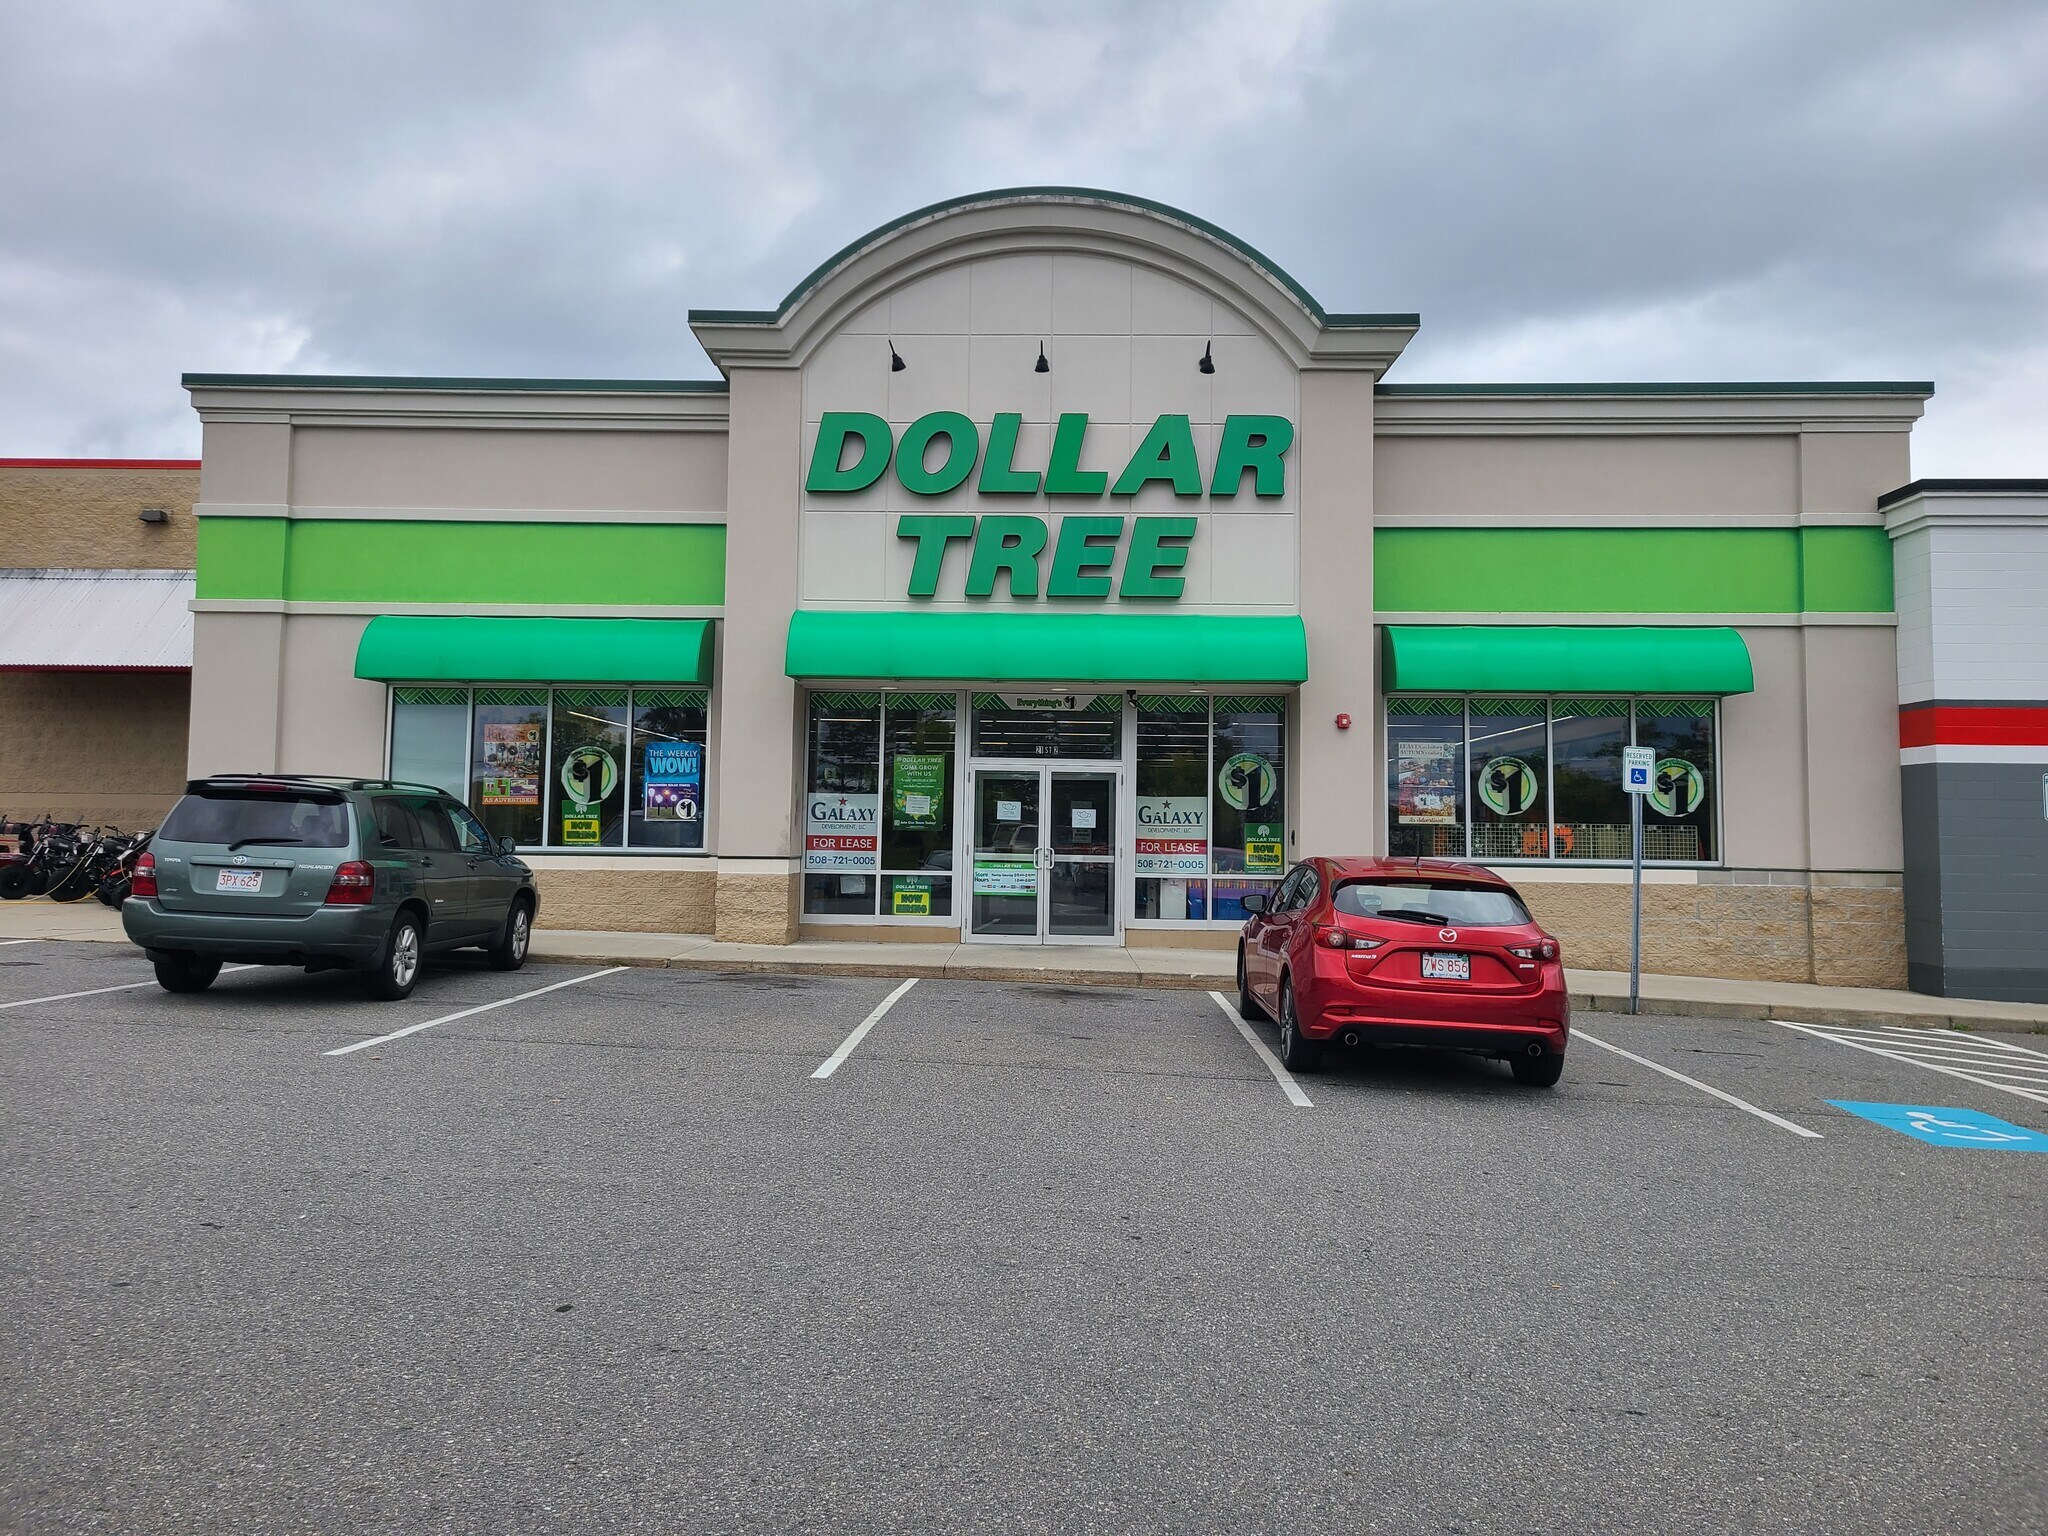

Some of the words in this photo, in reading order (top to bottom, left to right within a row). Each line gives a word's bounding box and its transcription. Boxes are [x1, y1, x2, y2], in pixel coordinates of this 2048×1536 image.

[804, 410, 1296, 497] DOLLAR
[896, 515, 1198, 599] TREE
[1016, 698, 1062, 708] Everything's
[649, 749, 664, 757] THE
[667, 749, 698, 757] WEEKLY
[1626, 752, 1653, 760] RESERVED
[649, 757, 698, 774] WOW!
[680, 801, 692, 818] $1
[570, 821, 593, 830] NOW
[813, 838, 836, 848] FOR
[840, 838, 873, 849] LEASE
[1140, 842, 1160, 852] FOR
[1164, 842, 1200, 853] LEASE
[1253, 844, 1276, 853] NOW
[808, 855, 876, 865] 508-721-0005
[1248, 854, 1280, 863] HIRING
[1137, 859, 1205, 869] 508-721-0005
[219, 874, 239, 886] 3PX
[240, 875, 259, 887] 625
[900, 894, 923, 904] NOW
[1424, 958, 1444, 972] 7WS
[1447, 959, 1468, 973] 856
